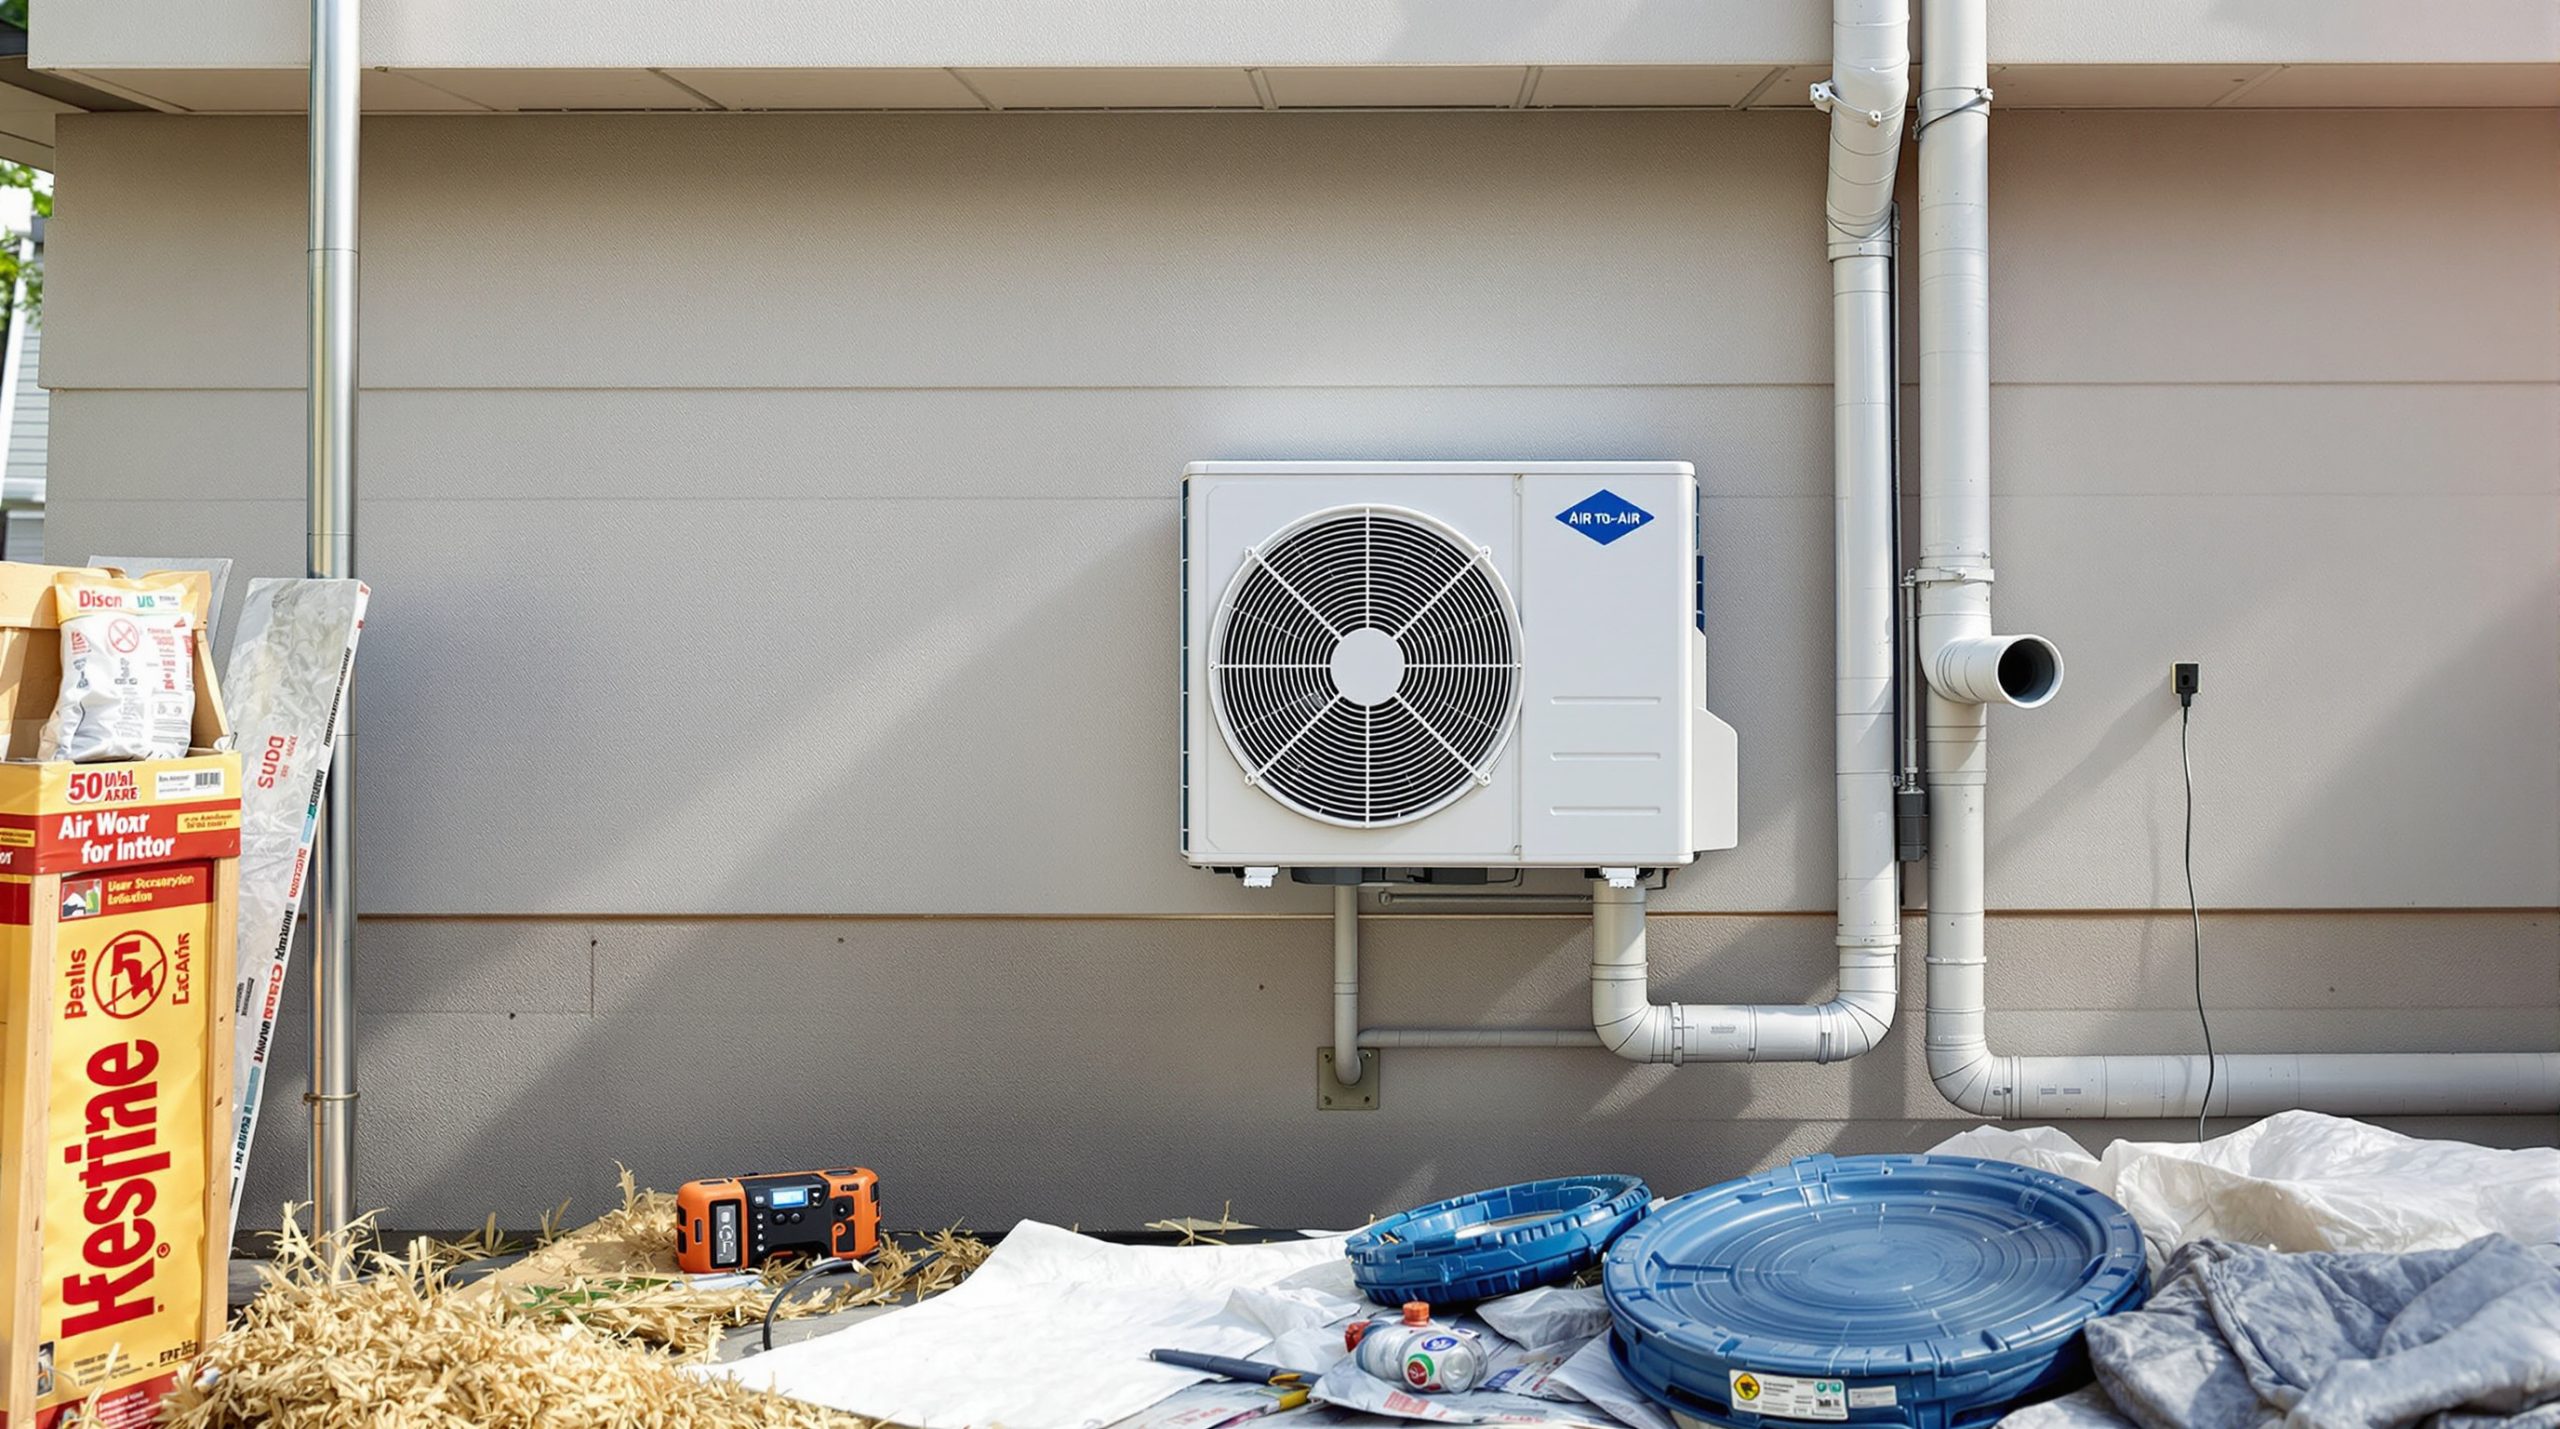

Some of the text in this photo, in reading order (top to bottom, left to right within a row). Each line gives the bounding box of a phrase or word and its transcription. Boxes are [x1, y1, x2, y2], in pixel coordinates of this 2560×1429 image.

[1569, 512, 1591, 524] AIR
[68, 772, 102, 801] 50
[58, 815, 93, 841] Air
[81, 841, 114, 864] for
